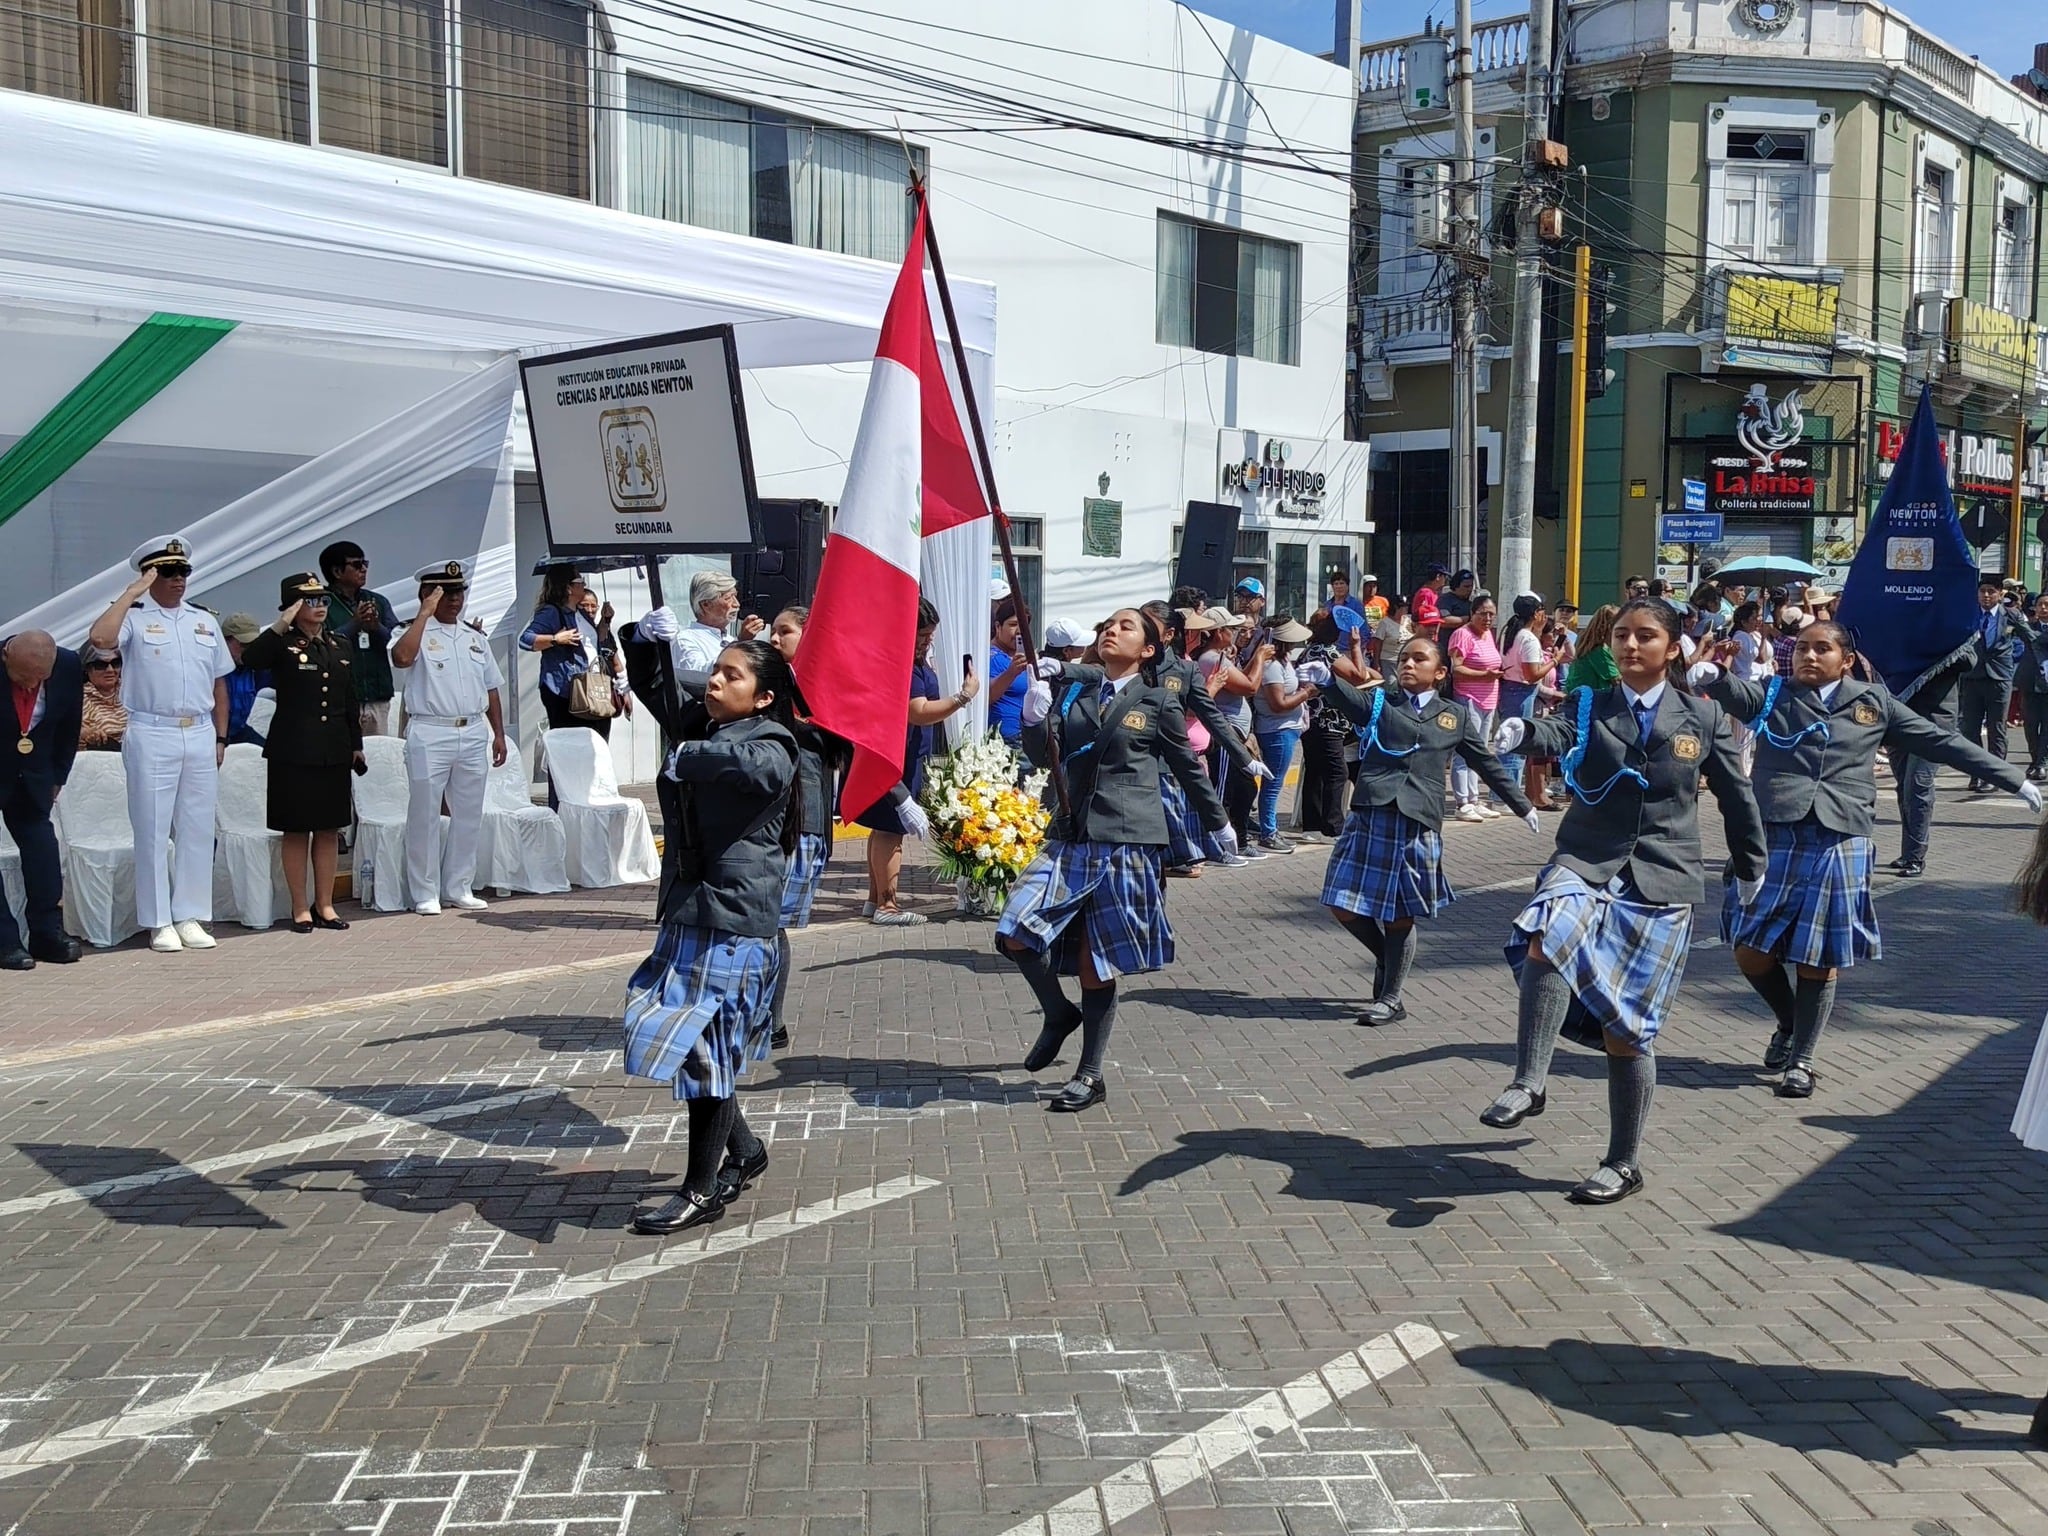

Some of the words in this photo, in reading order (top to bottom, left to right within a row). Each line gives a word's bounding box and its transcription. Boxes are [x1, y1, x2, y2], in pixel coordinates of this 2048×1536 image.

[557, 368, 605, 387] INSTITUCIÓN
[605, 363, 650, 381] EDUCATIVA
[651, 358, 687, 376] PRIVADA
[556, 386, 597, 407] CIENCIAS
[600, 381, 649, 401] APLICADAS
[651, 375, 693, 395] NEWTON
[1717, 457, 1750, 468] DESDE
[1779, 458, 1803, 468] 1999
[1960, 435, 2014, 481] Pollos
[1715, 470, 1746, 495] La
[1751, 470, 1815, 495] Brisa
[1721, 499, 1757, 509] Pollería
[1760, 499, 1810, 509] tradicional
[1889, 508, 1937, 519] NEWTON
[615, 521, 673, 535] SECUNDARIA
[1685, 519, 1716, 528] Bolognesi
[1669, 530, 1692, 539] Pasaje
[1693, 530, 1713, 538] Arica
[1884, 585, 1933, 594] MOLLENDO
